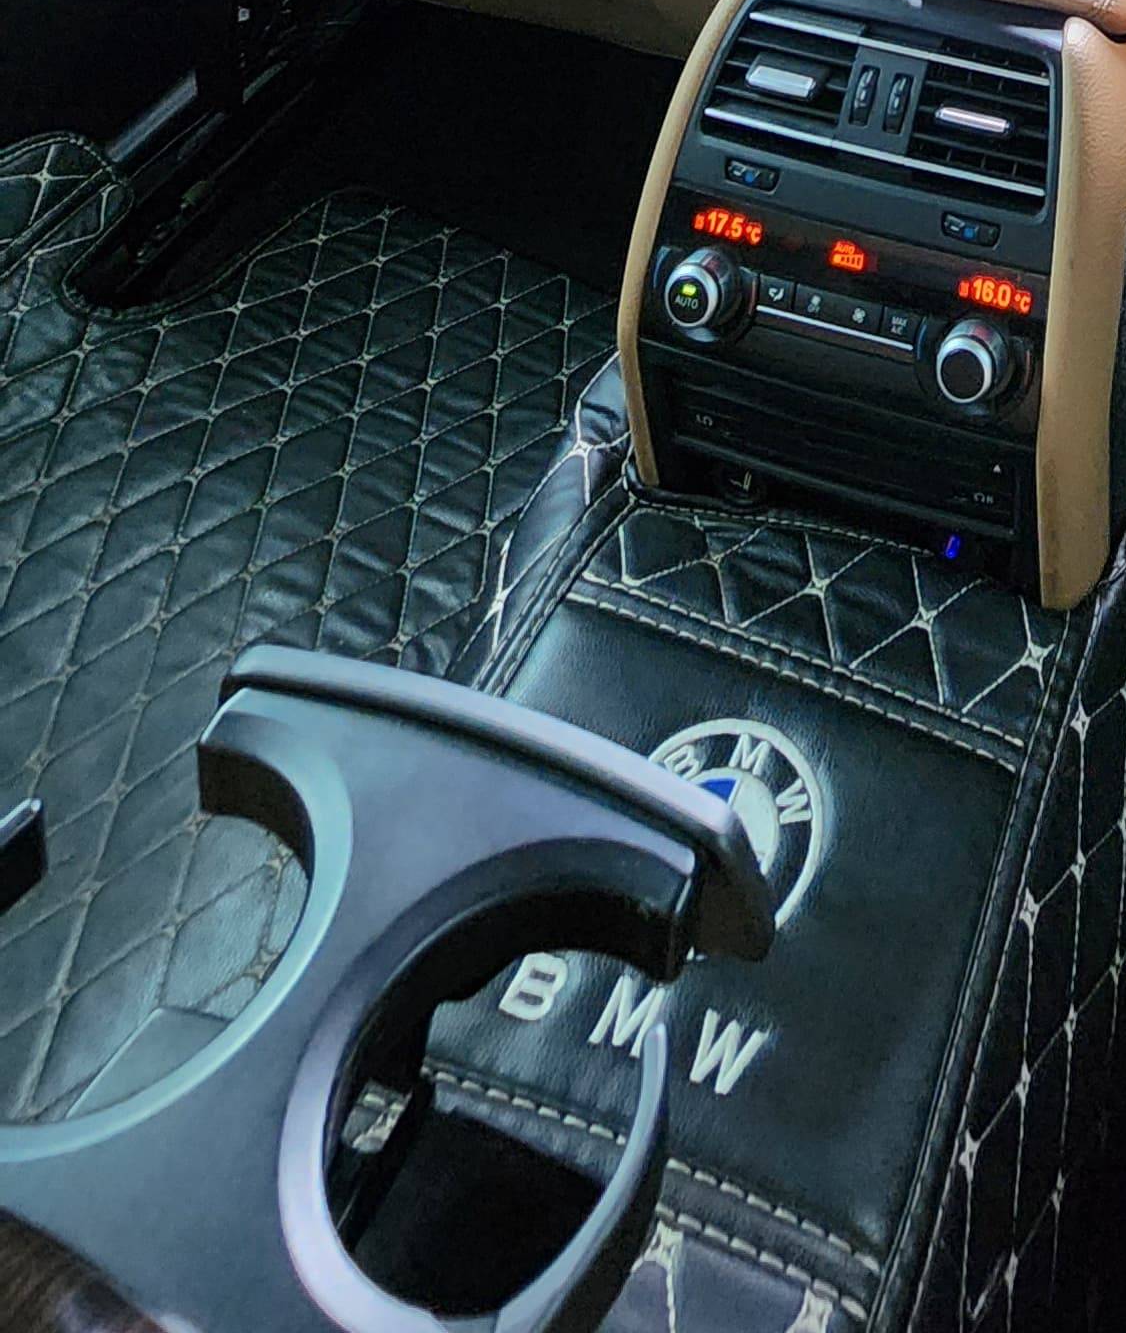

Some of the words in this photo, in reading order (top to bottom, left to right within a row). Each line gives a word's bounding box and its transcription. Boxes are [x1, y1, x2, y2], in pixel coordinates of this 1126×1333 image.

[708, 211, 743, 238] 17.5
[834, 242, 856, 255] AUTO
[674, 295, 698, 310] AUTO
[973, 278, 1012, 307] 16.0
[663, 733, 812, 824] BMW
